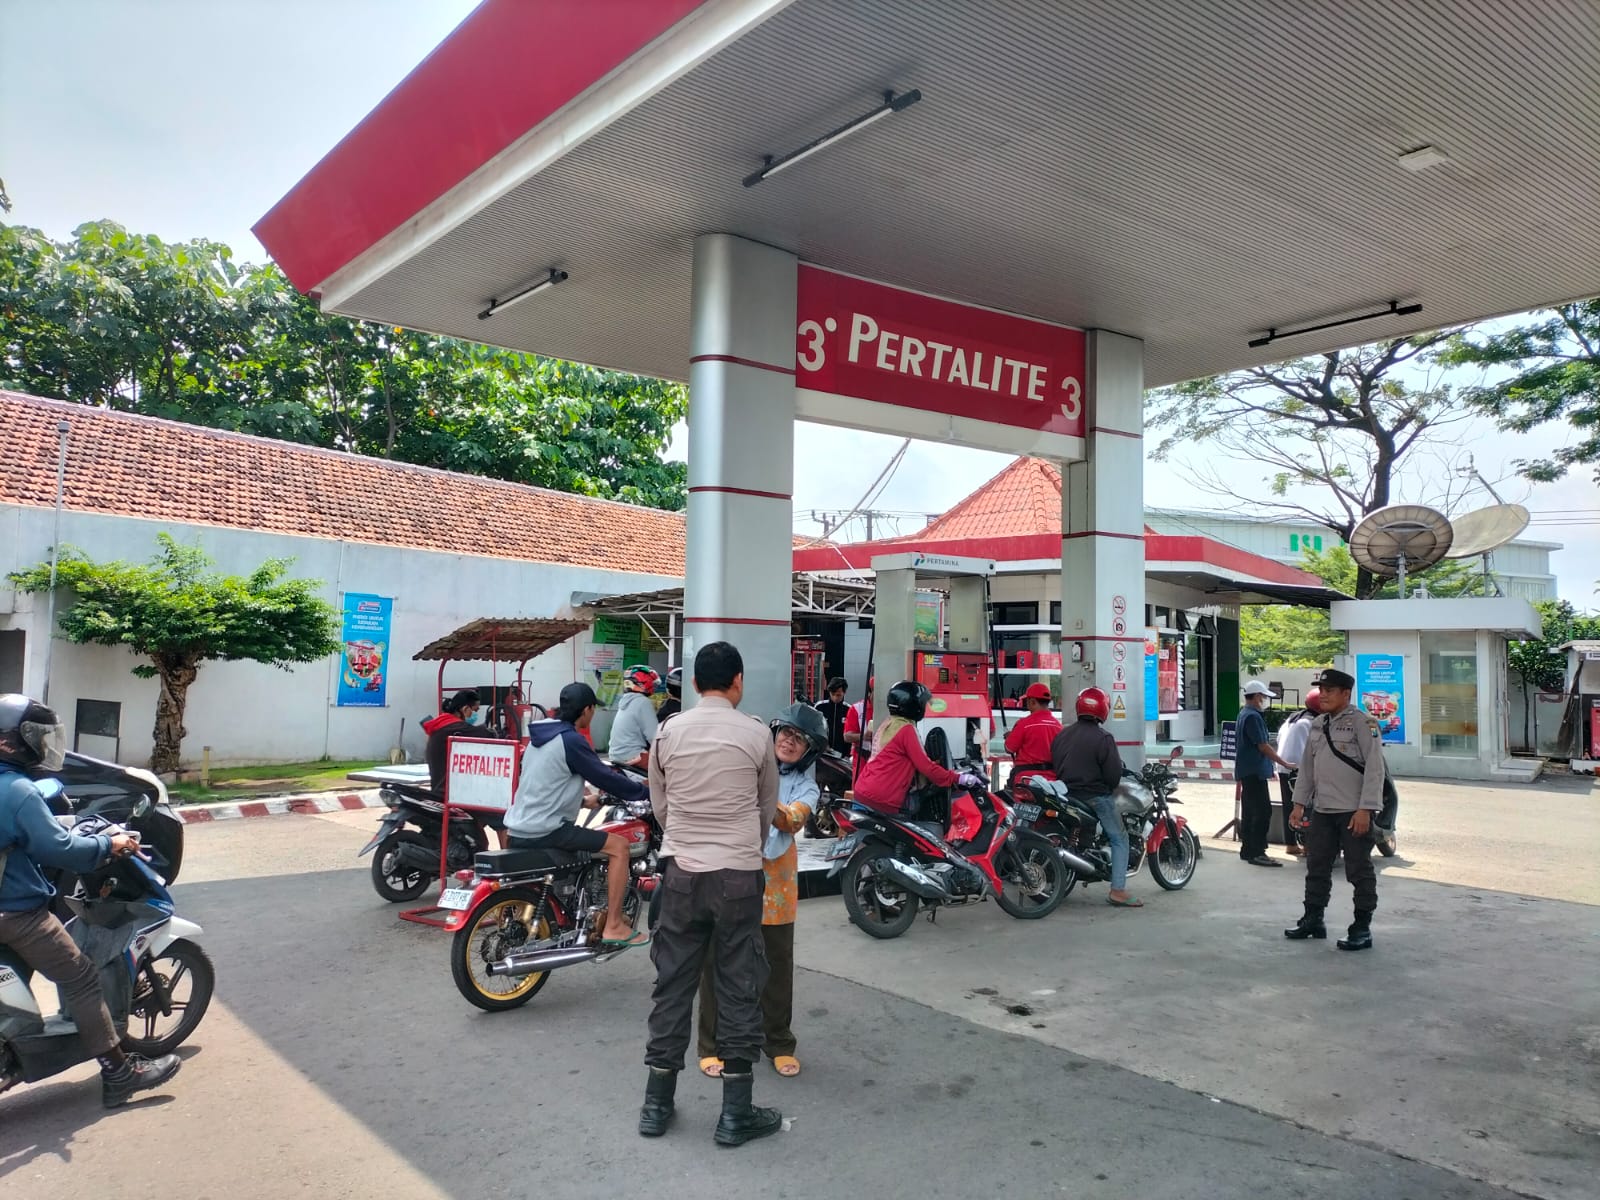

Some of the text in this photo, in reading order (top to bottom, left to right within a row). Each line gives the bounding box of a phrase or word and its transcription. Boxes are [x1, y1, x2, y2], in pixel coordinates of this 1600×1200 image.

[848, 312, 1048, 401] PERTALITE
[1060, 376, 1082, 421] 3
[927, 558, 960, 566] PERTAMINA
[452, 754, 511, 778] PERTALITE
